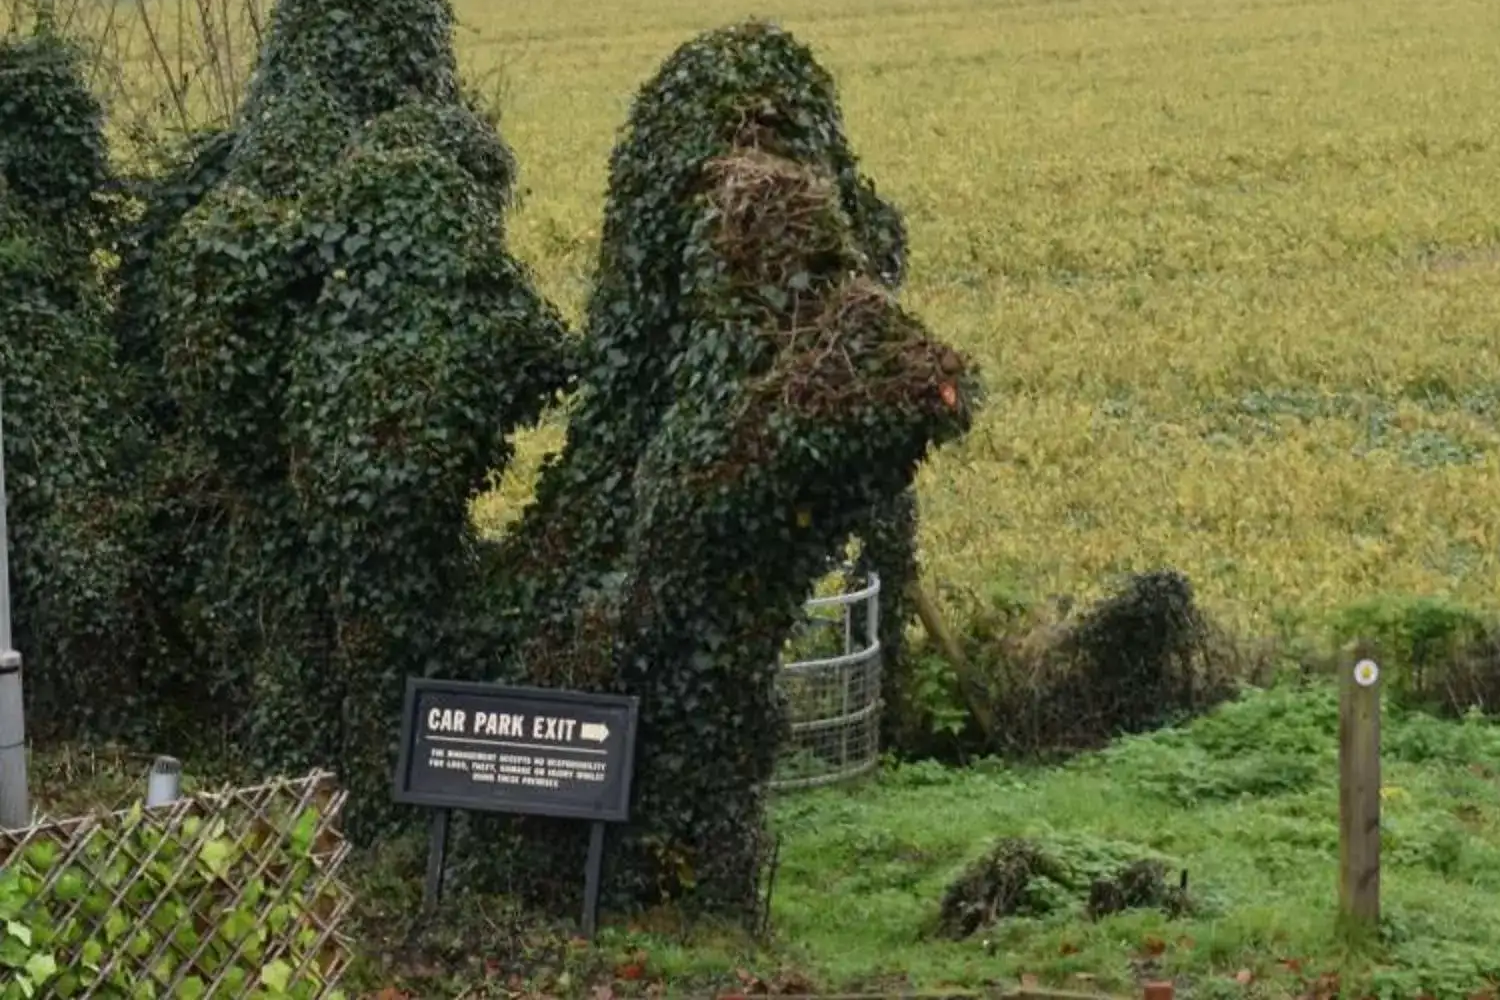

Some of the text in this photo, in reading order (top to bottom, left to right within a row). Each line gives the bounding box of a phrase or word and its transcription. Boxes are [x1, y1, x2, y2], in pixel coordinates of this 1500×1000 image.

[427, 707, 576, 742] CAR PARK EXIT
